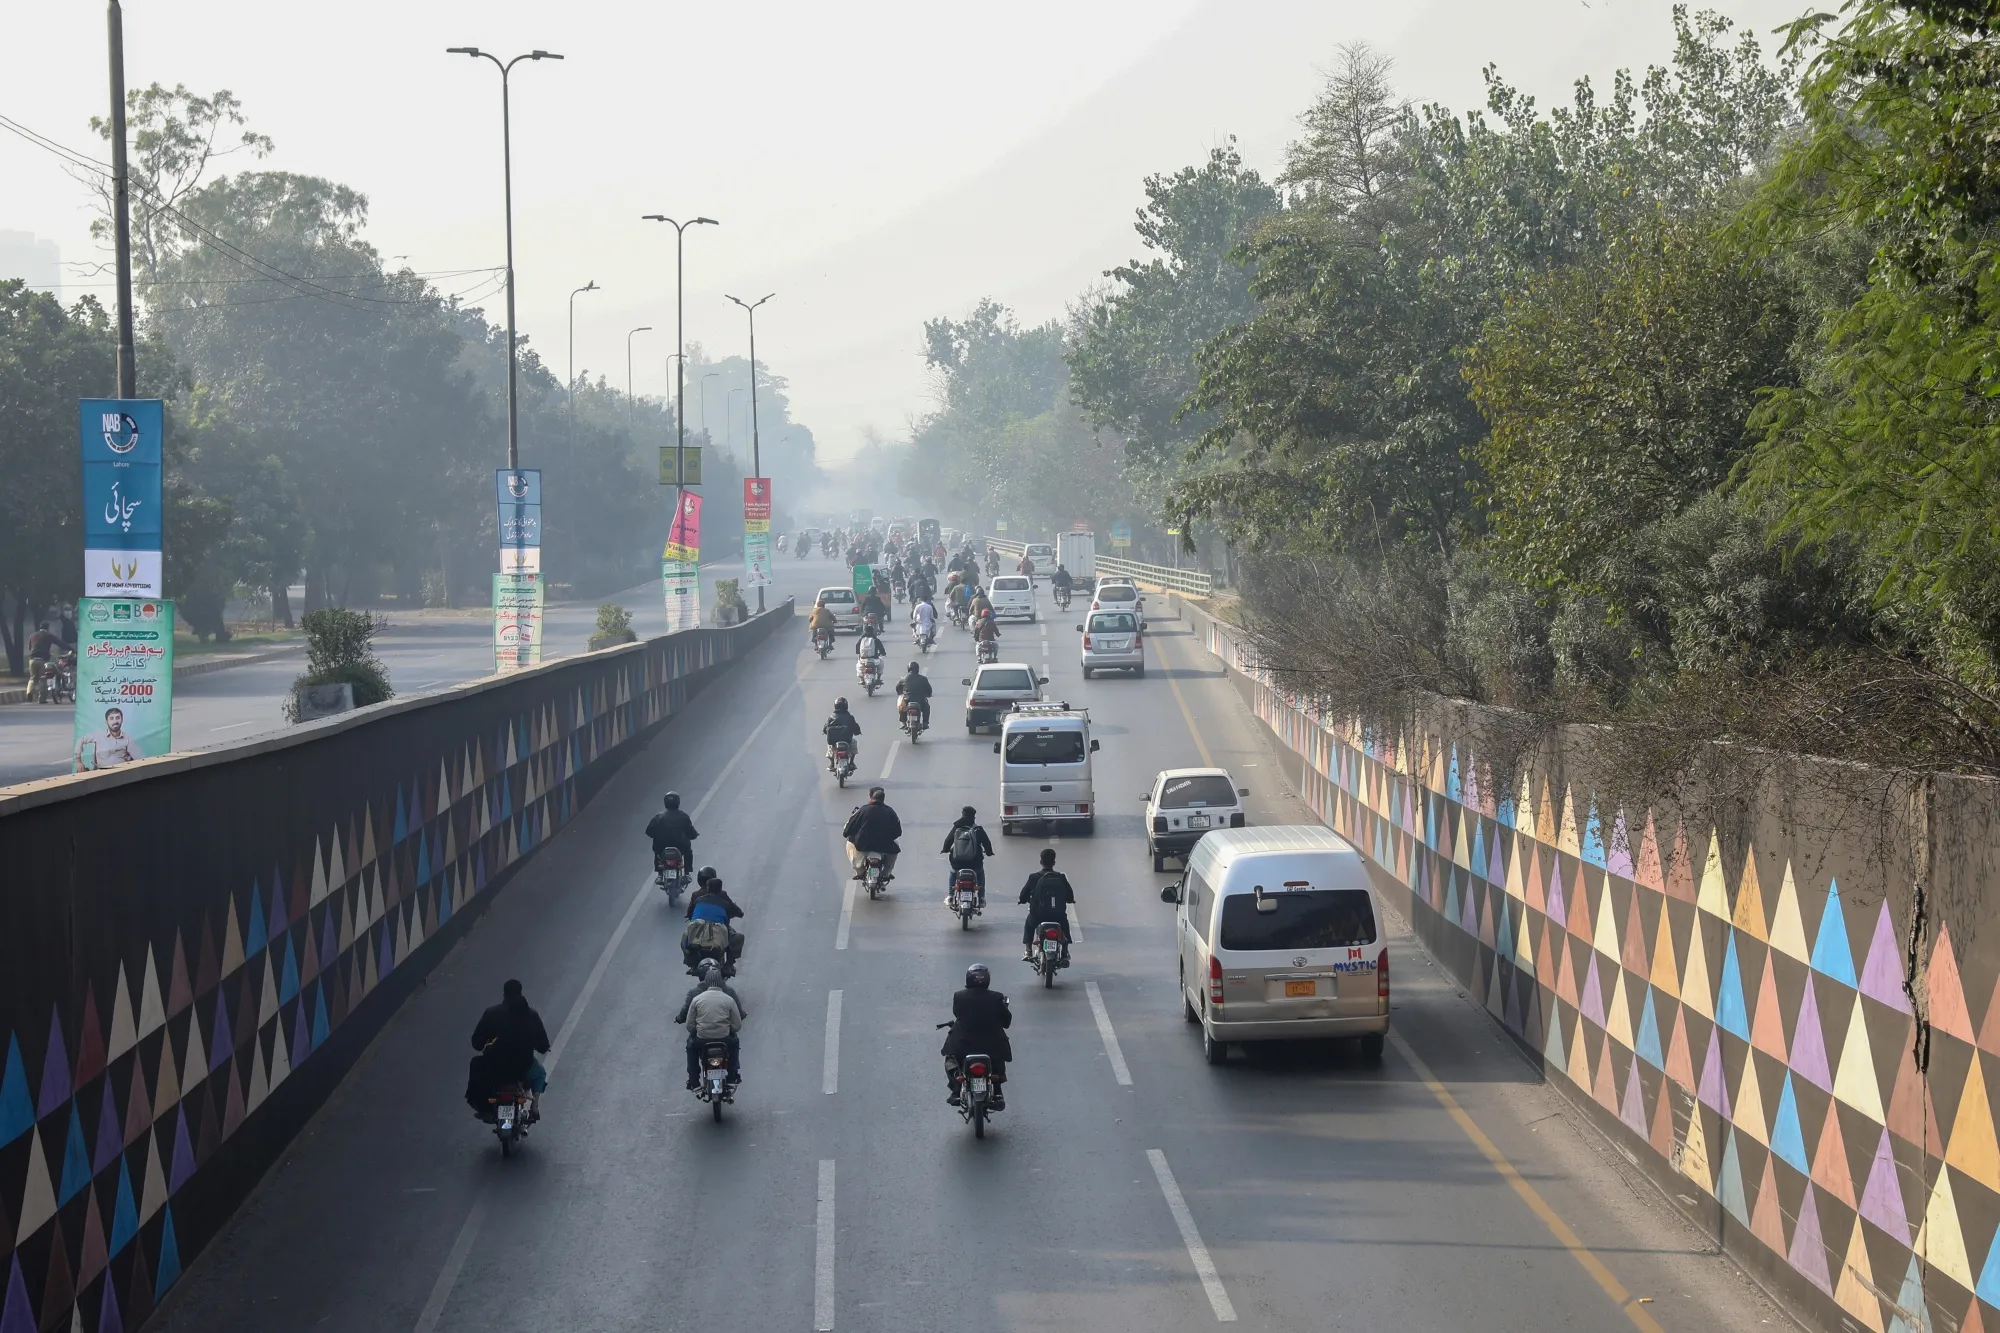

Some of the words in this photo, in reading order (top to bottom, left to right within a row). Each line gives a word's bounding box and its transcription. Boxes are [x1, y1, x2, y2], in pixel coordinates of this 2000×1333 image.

[102, 413, 121, 432] NAB
[105, 482, 142, 532] سچائی
[120, 684, 153, 696] 2000
[1333, 959, 1378, 973] MYSTIC
